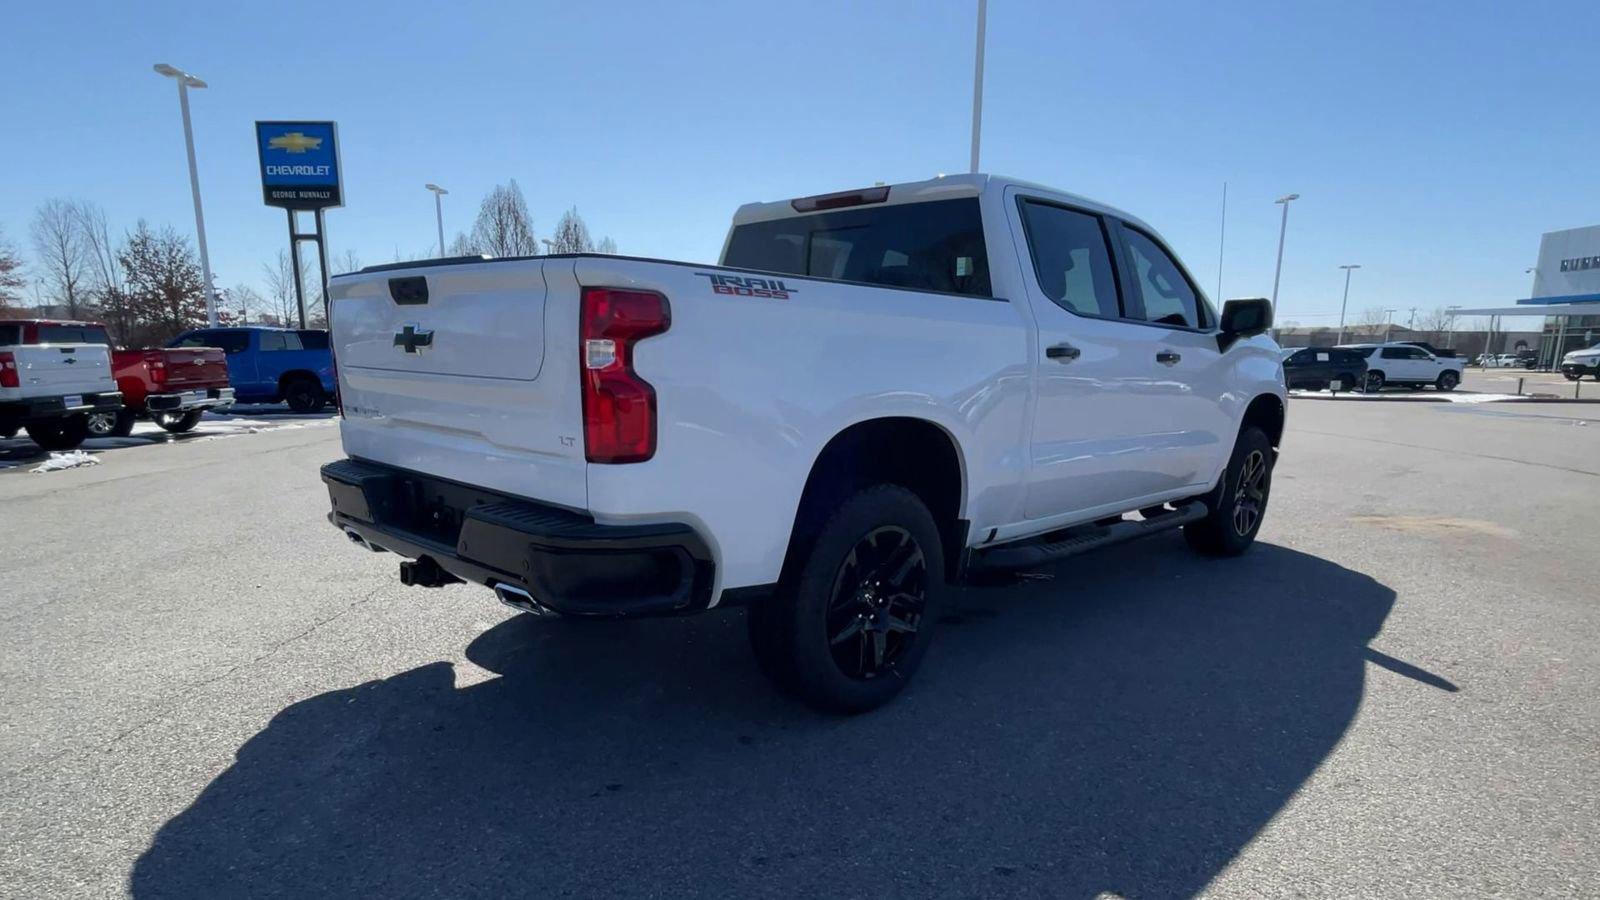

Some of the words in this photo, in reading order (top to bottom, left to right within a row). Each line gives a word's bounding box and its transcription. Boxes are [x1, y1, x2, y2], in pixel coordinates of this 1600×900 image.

[266, 165, 330, 176] CHEVROLET
[272, 190, 297, 199] GEORGE
[694, 272, 798, 293] TRAIL
[713, 285, 789, 300] BOSS
